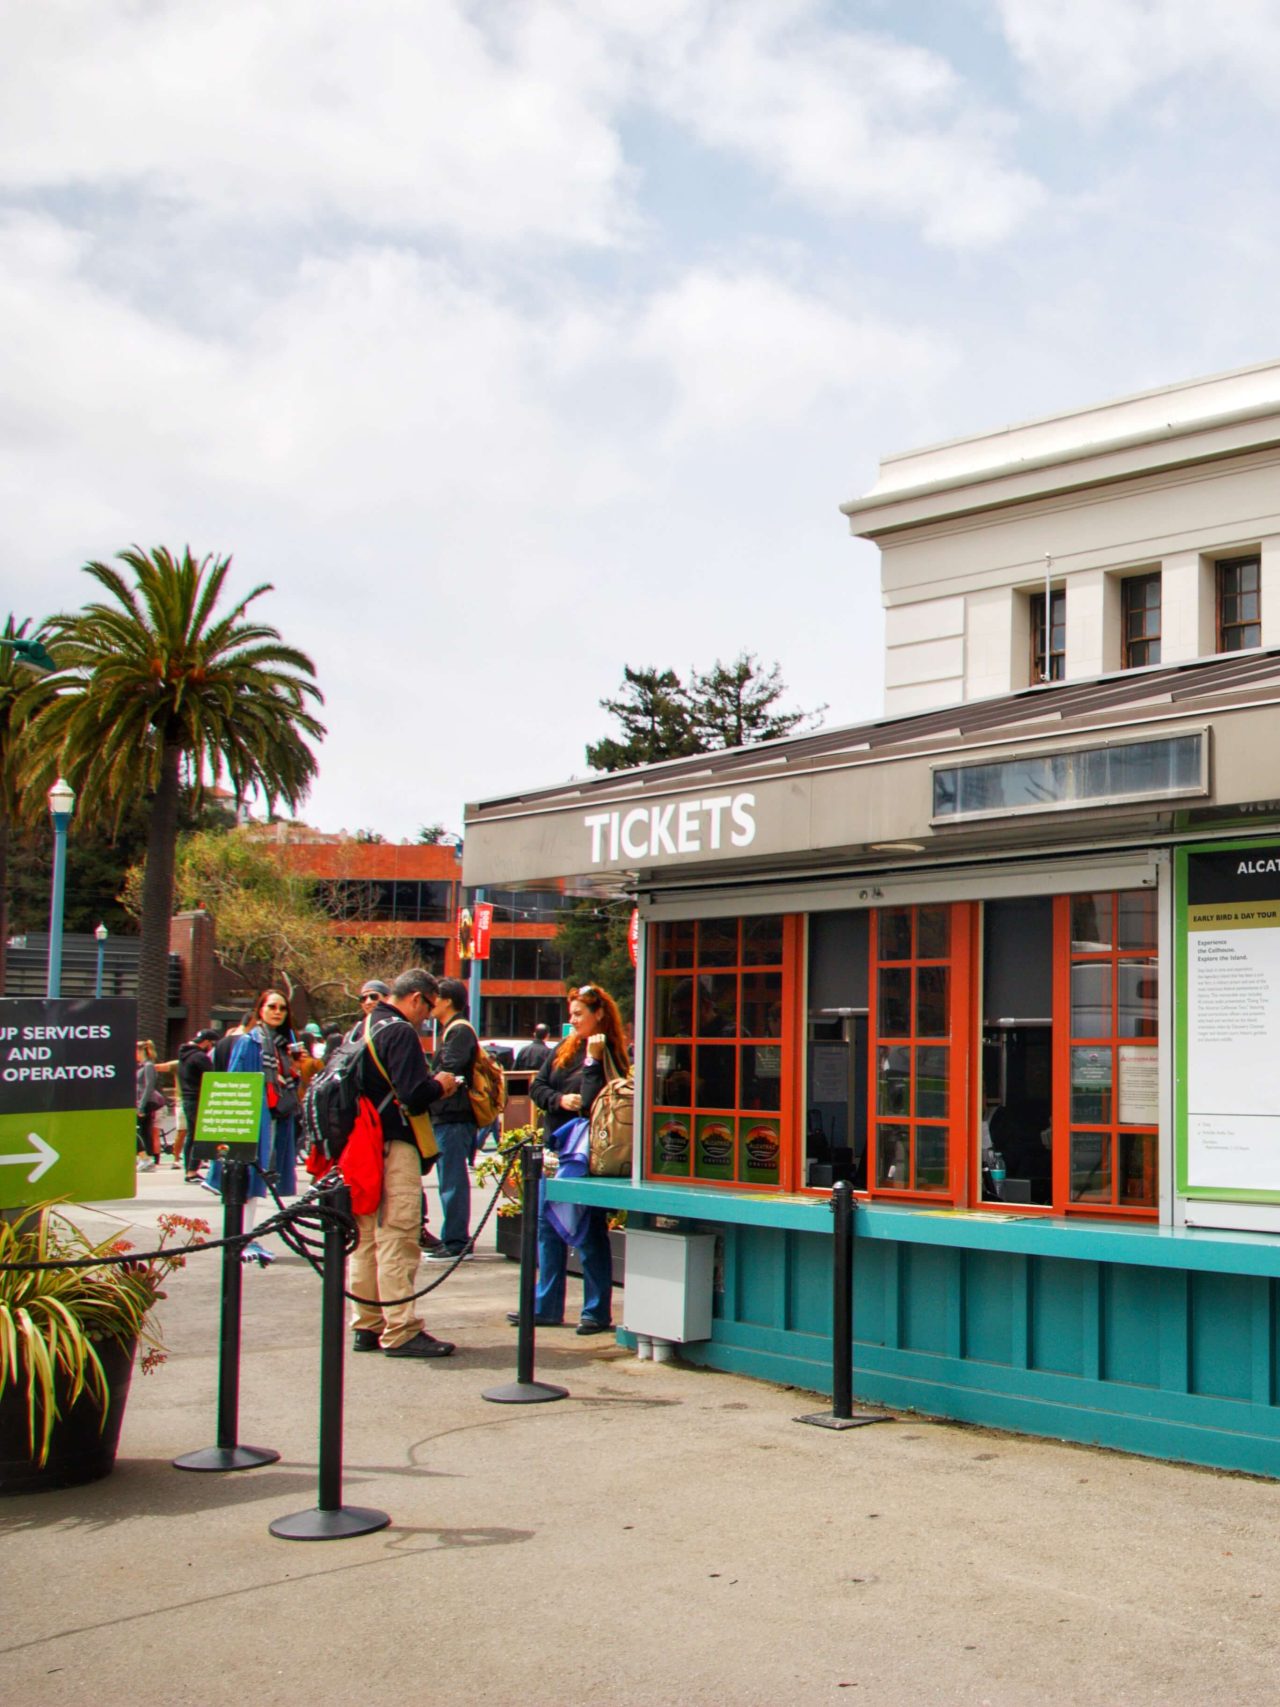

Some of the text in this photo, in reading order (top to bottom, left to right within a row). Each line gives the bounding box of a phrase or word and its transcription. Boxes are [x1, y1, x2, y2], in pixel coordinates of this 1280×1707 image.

[584, 793, 756, 863] TICKETS
[23, 1026, 111, 1040] SERVICES
[8, 1047, 51, 1060] AND
[3, 1065, 115, 1081] OPERATORS
